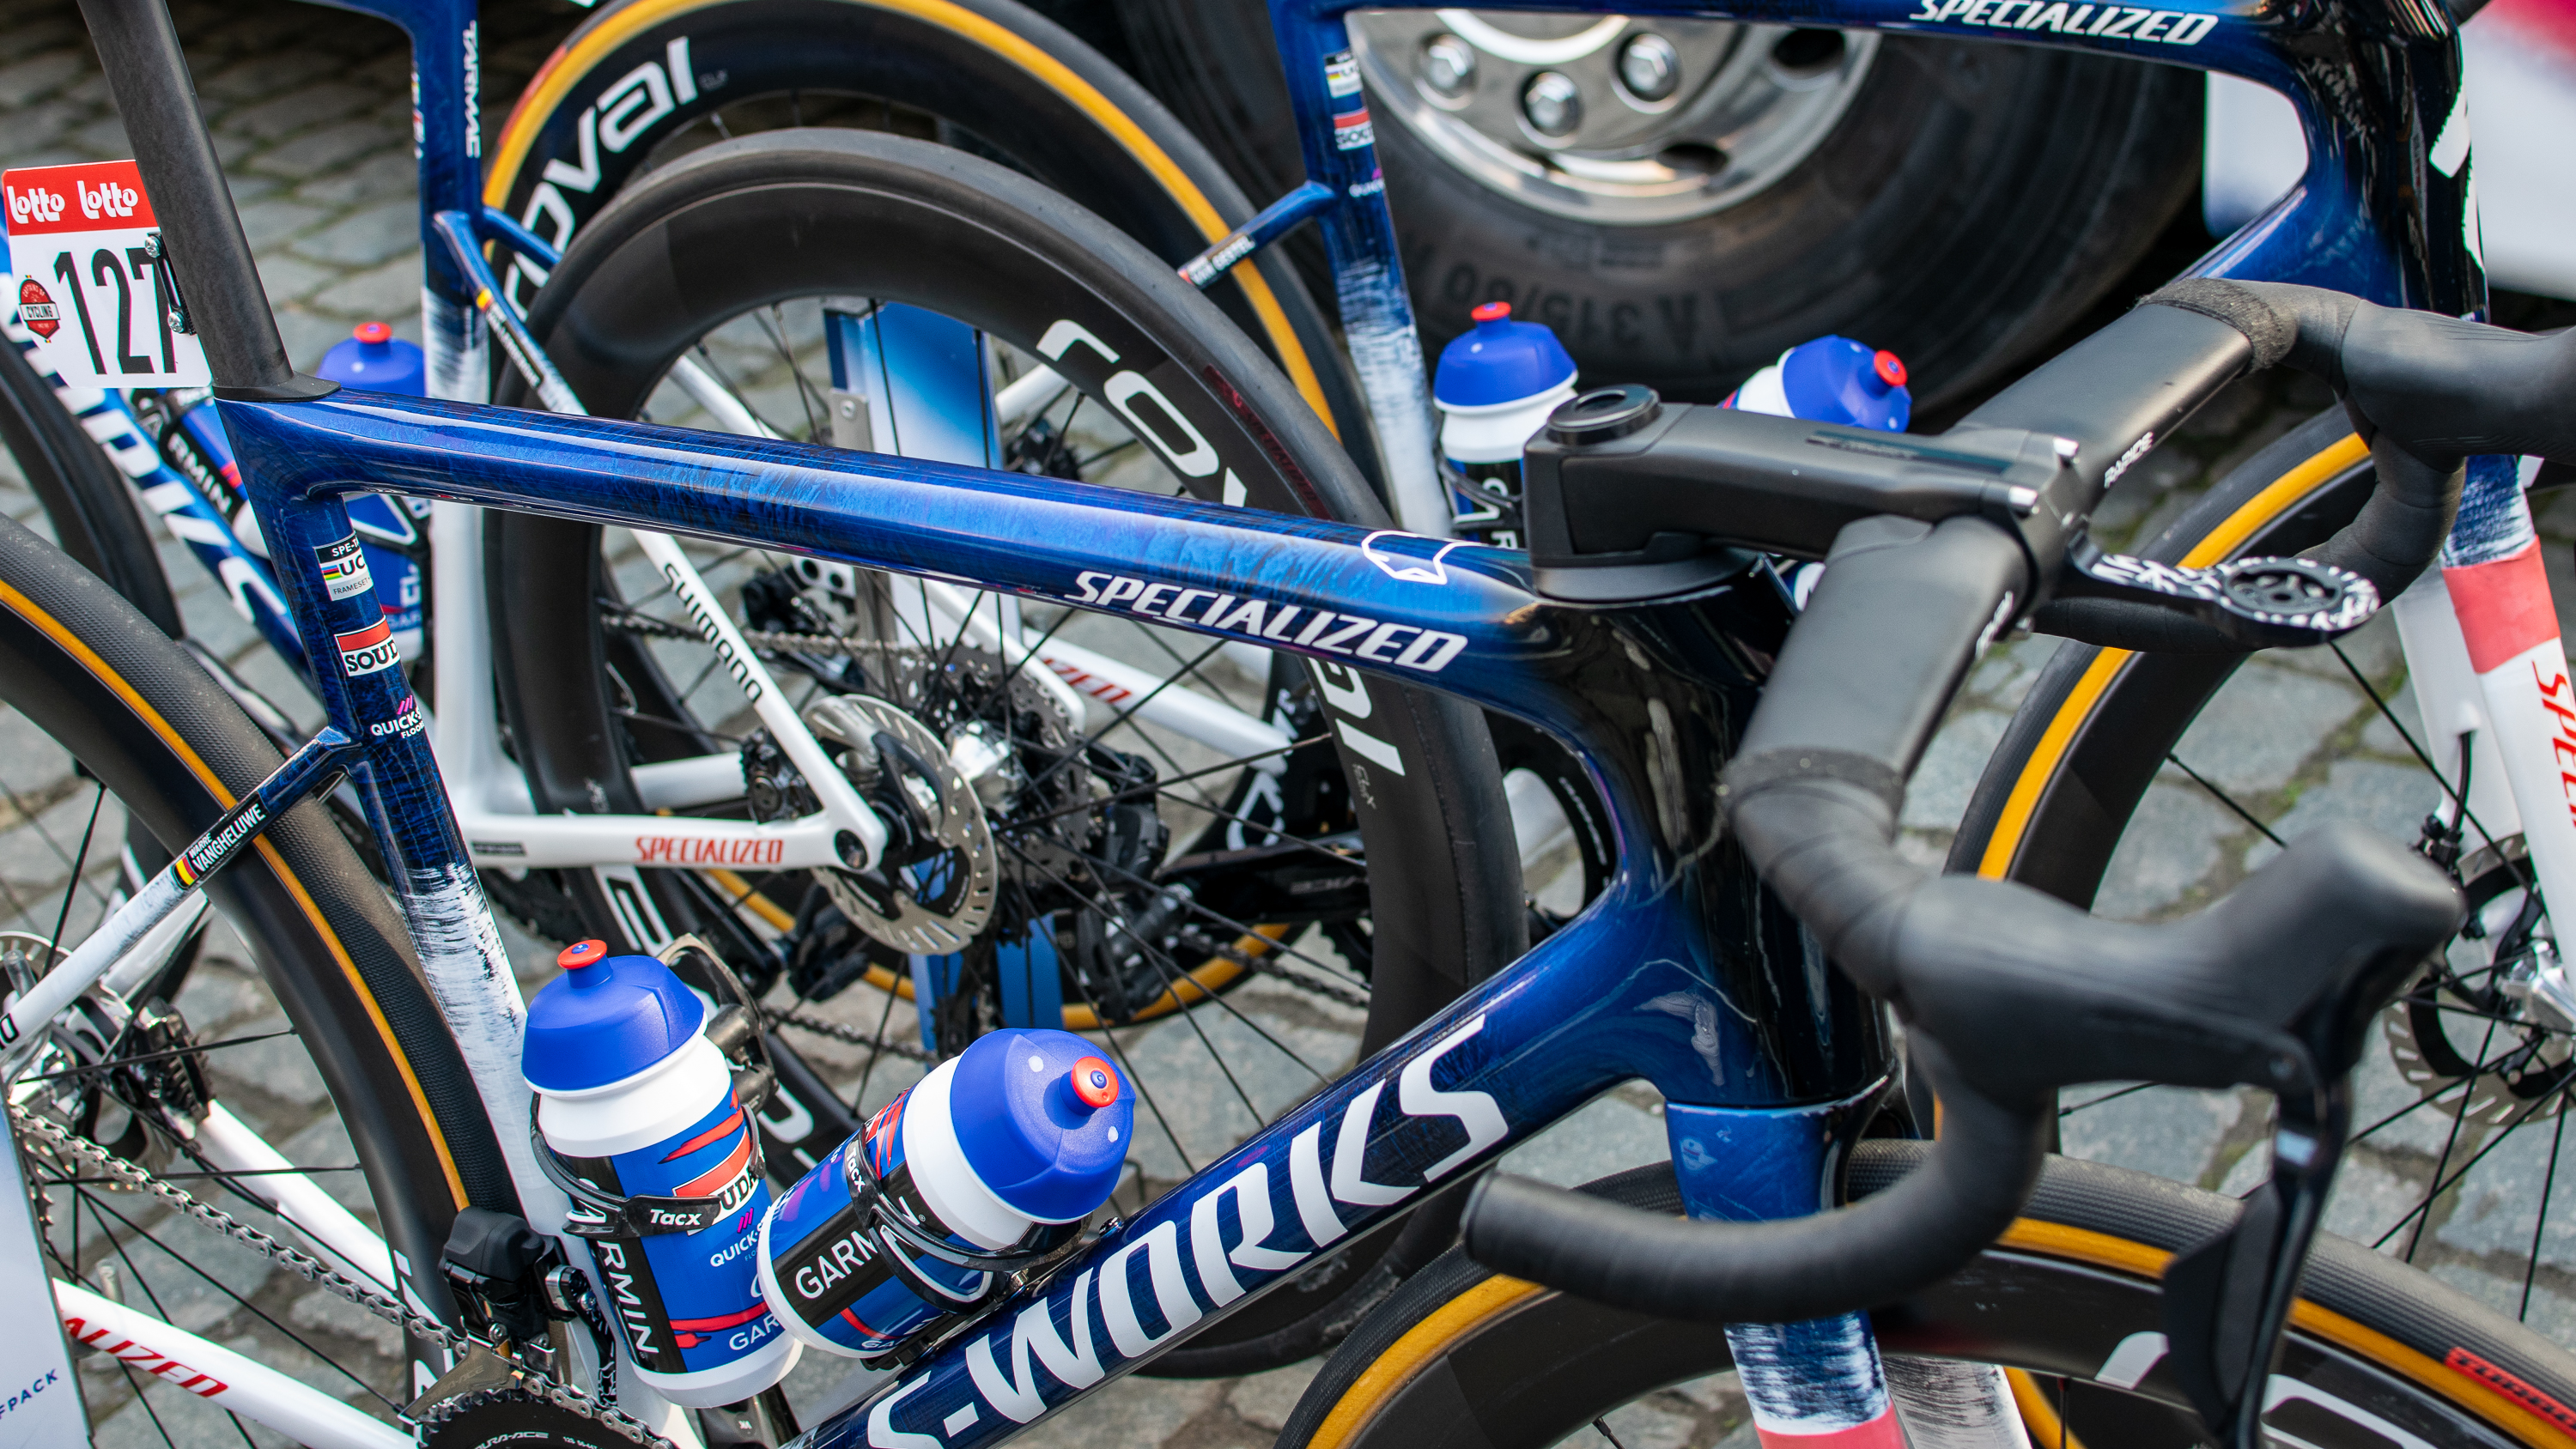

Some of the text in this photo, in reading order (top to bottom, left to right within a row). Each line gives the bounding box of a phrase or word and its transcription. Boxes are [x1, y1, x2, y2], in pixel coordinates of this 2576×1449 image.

[1910, 0, 2219, 45] SPECIALIZED
[26, 305, 53, 318] CYCLING
[53, 247, 177, 375] 127
[2104, 431, 2154, 489] RAPIDE
[1065, 570, 1468, 672] SPECIALIZED
[188, 832, 213, 858] WARRE
[191, 803, 266, 872] VANGHELUWE
[636, 836, 783, 865] SPECIALIZED
[847, 1146, 866, 1194] Tacx
[649, 1208, 702, 1226] Tacx
[867, 1014, 1509, 1449] S-WORKS
